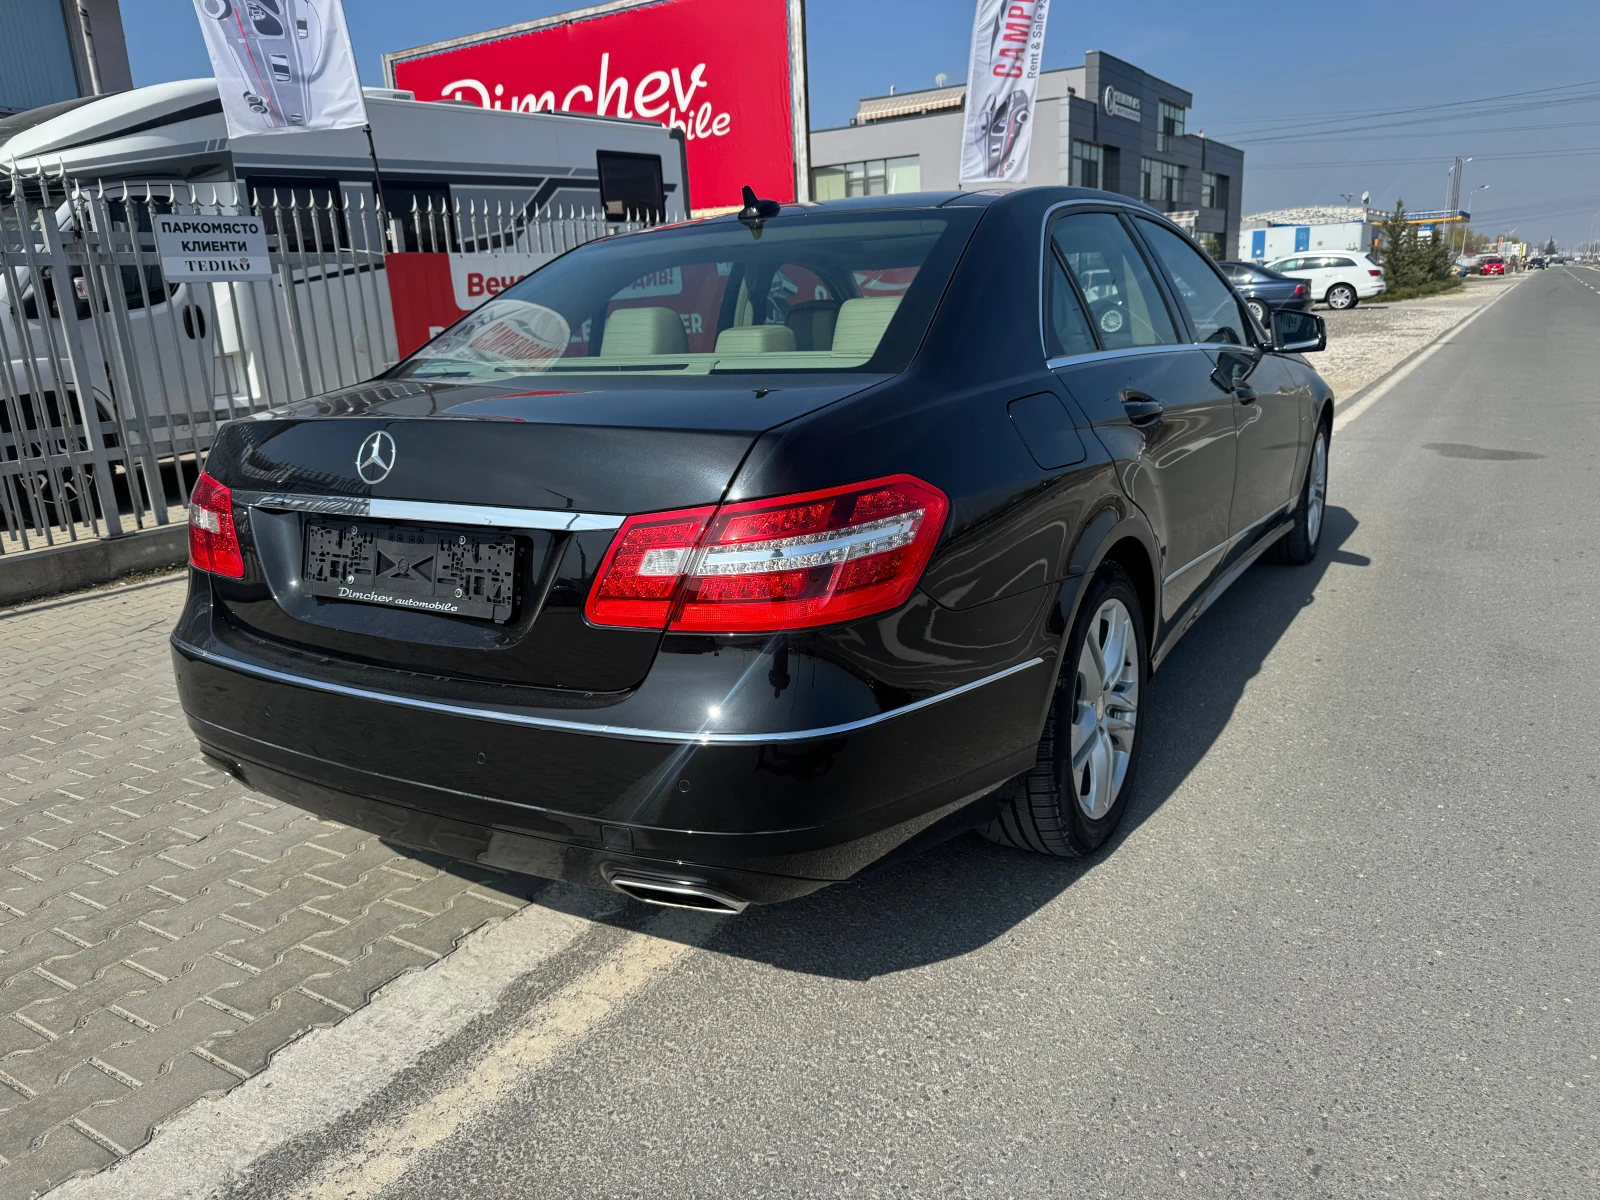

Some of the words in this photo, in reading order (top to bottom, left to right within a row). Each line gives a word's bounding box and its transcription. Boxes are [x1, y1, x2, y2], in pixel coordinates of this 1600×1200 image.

[1032, 13, 1045, 38] Sale
[992, 0, 1035, 79] CAMP
[1030, 42, 1041, 50] &
[1027, 53, 1039, 79] Rent
[441, 53, 708, 119] Dimchev
[161, 222, 259, 234] ПАРКОМЯСТО
[181, 241, 248, 252] КЛИЕНТИ
[338, 587, 393, 603] Dimchev
[395, 599, 458, 612] automobile
